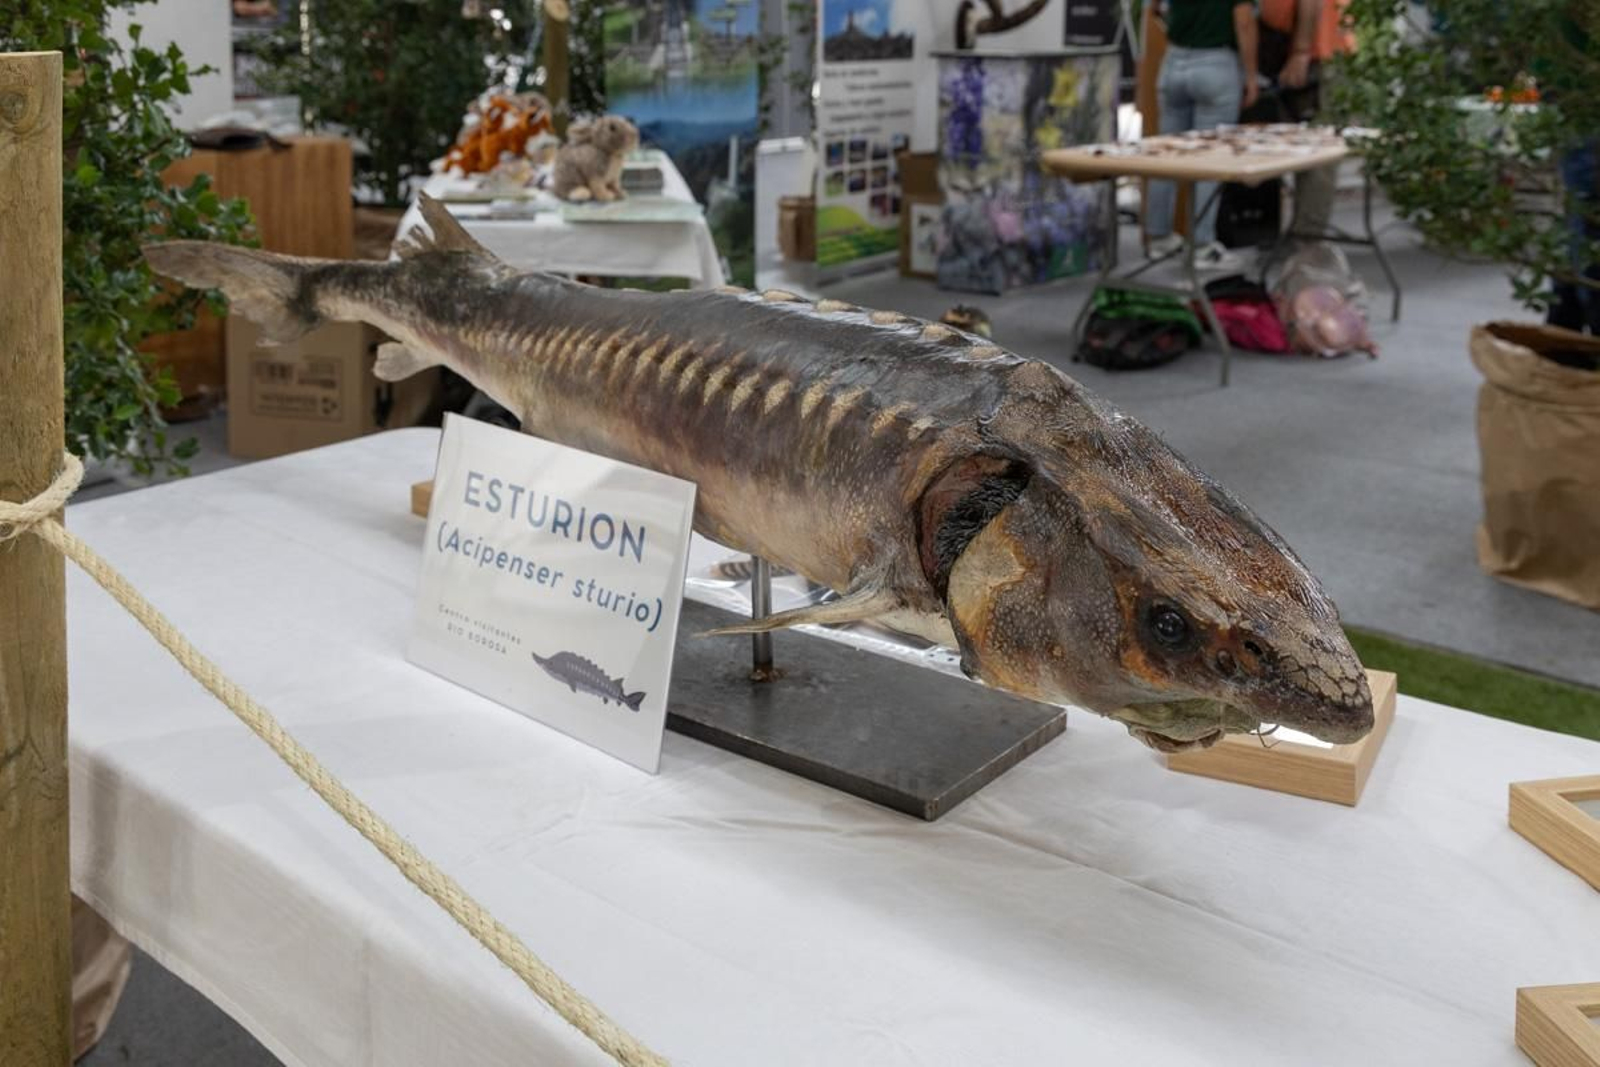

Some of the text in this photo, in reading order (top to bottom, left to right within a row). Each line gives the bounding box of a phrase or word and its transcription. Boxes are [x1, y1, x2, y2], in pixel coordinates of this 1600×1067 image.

[464, 471, 645, 564] ESTURION
[437, 521, 662, 632] (Acipenser sturio)
